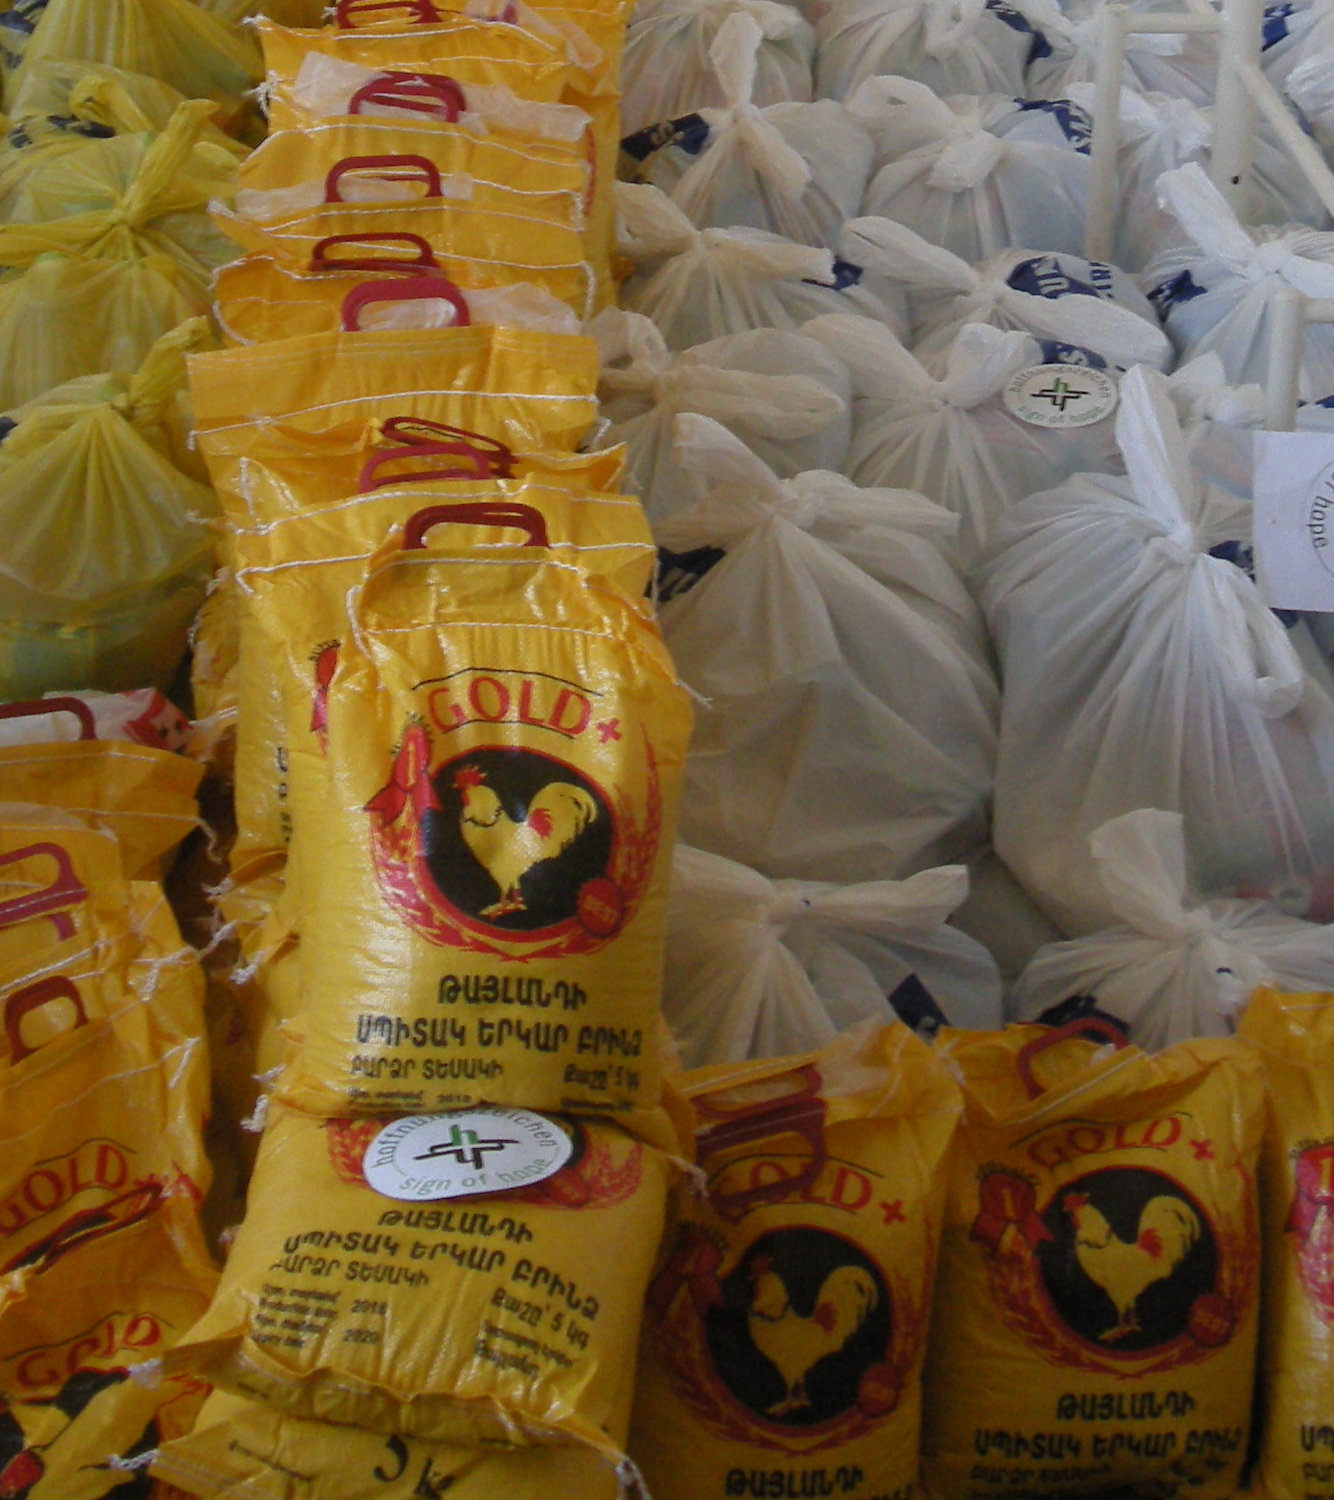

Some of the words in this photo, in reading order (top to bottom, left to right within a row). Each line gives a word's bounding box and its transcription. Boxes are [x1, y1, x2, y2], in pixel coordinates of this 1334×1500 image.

[1306, 495, 1333, 549] hope
[438, 974, 588, 1011] ԹԱՅԼԱՆԴԻ
[356, 1014, 466, 1048] ՍՊԻՏԱԿ
[478, 1018, 570, 1053] ԵՐԿԱՐ
[399, 1175, 451, 1197] sign
[461, 1174, 487, 1188] of
[377, 1208, 533, 1244] ԹԱՅԼԱՆԴԻ
[283, 1230, 400, 1256] ՍՊԻՏԱԿ
[410, 1241, 505, 1273] ԵՐԿԱՐ
[512, 1258, 601, 1321] ԲՐԻՆՁ
[345, 1260, 430, 1287] ՏԵՍԱԿԻ
[1056, 1391, 1196, 1421] ԹԱՅԼԱՆԴԻ
[973, 1429, 1082, 1459] ՍՊԻՏԱԿ
[1091, 1430, 1175, 1458] ԵՐԿԱՐ
[725, 1465, 864, 1498] ԹԱՅԼԱՆԴԻ
